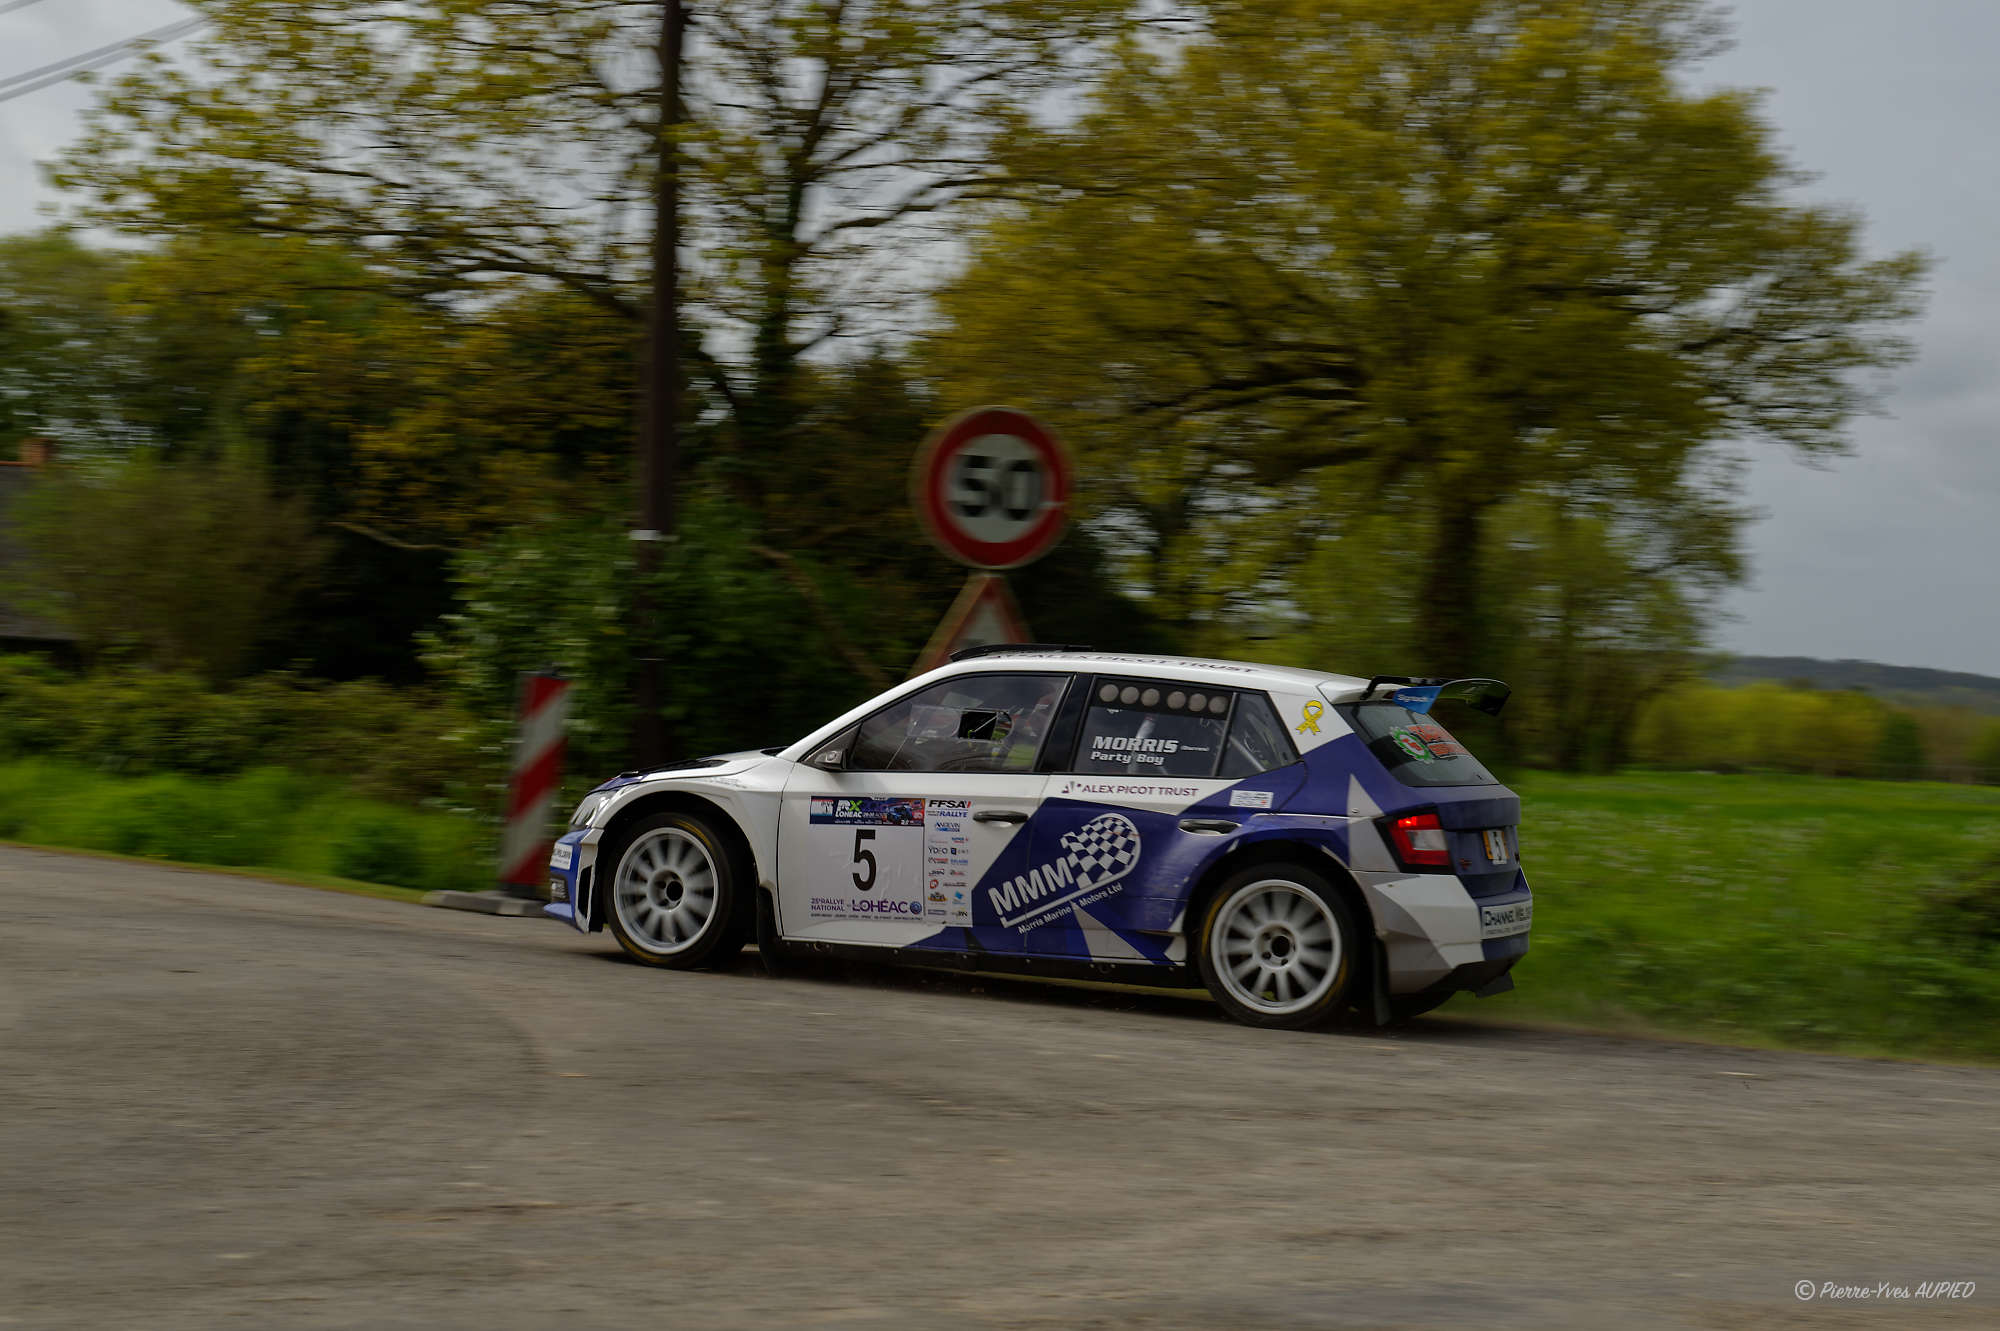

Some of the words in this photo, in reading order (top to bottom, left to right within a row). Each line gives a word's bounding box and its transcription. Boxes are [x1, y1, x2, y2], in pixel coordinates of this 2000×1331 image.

[955, 454, 1041, 522] 50
[1176, 661, 1260, 673] TRUST
[1092, 736, 1179, 753] MORRIS
[1091, 751, 1132, 763] Party
[1136, 753, 1164, 766] Boy
[1082, 785, 1114, 794] ALEX
[1117, 786, 1155, 794] PICOT
[1159, 787, 1199, 796] TRUST
[929, 800, 966, 808] FFSA
[852, 829, 876, 891] 5
[988, 857, 1074, 915] MMM
[852, 898, 908, 913] LOHÉAC
[1018, 918, 1043, 935] Morris
[1044, 906, 1073, 923] Marine
[1078, 891, 1109, 907] Motors
[1108, 883, 1123, 895] Ltd
